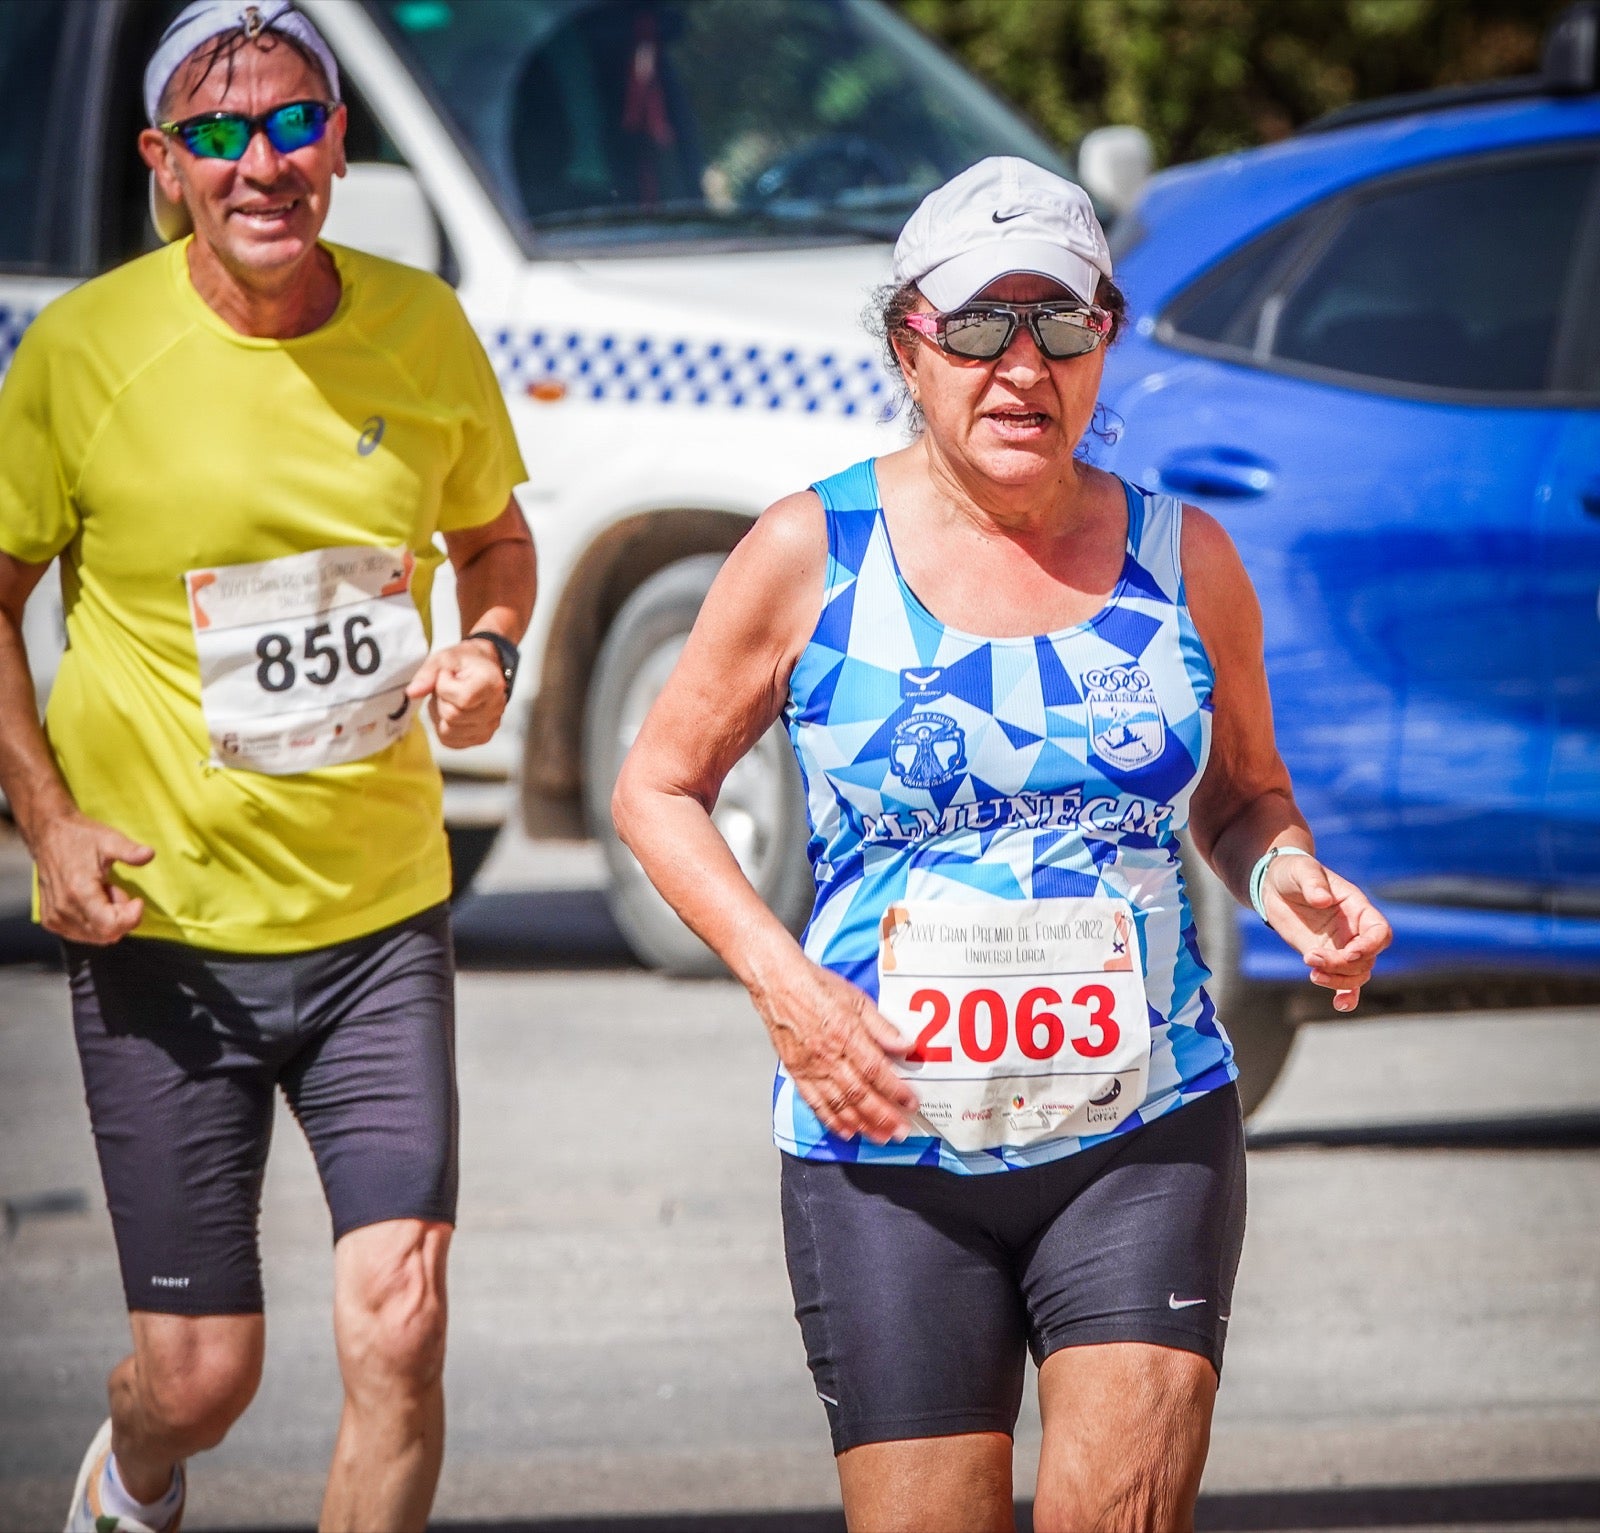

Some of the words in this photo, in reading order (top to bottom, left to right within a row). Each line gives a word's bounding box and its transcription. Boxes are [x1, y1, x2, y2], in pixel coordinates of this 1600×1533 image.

[256, 615, 381, 693] 856
[855, 787, 1174, 852] ALMUÑÉCAR
[965, 947, 1012, 964] UNIVERSO
[1016, 946, 1046, 963] LORCA
[973, 923, 1013, 943] PREMIO
[1075, 919, 1103, 940] 2022
[905, 984, 1120, 1063] 2063
